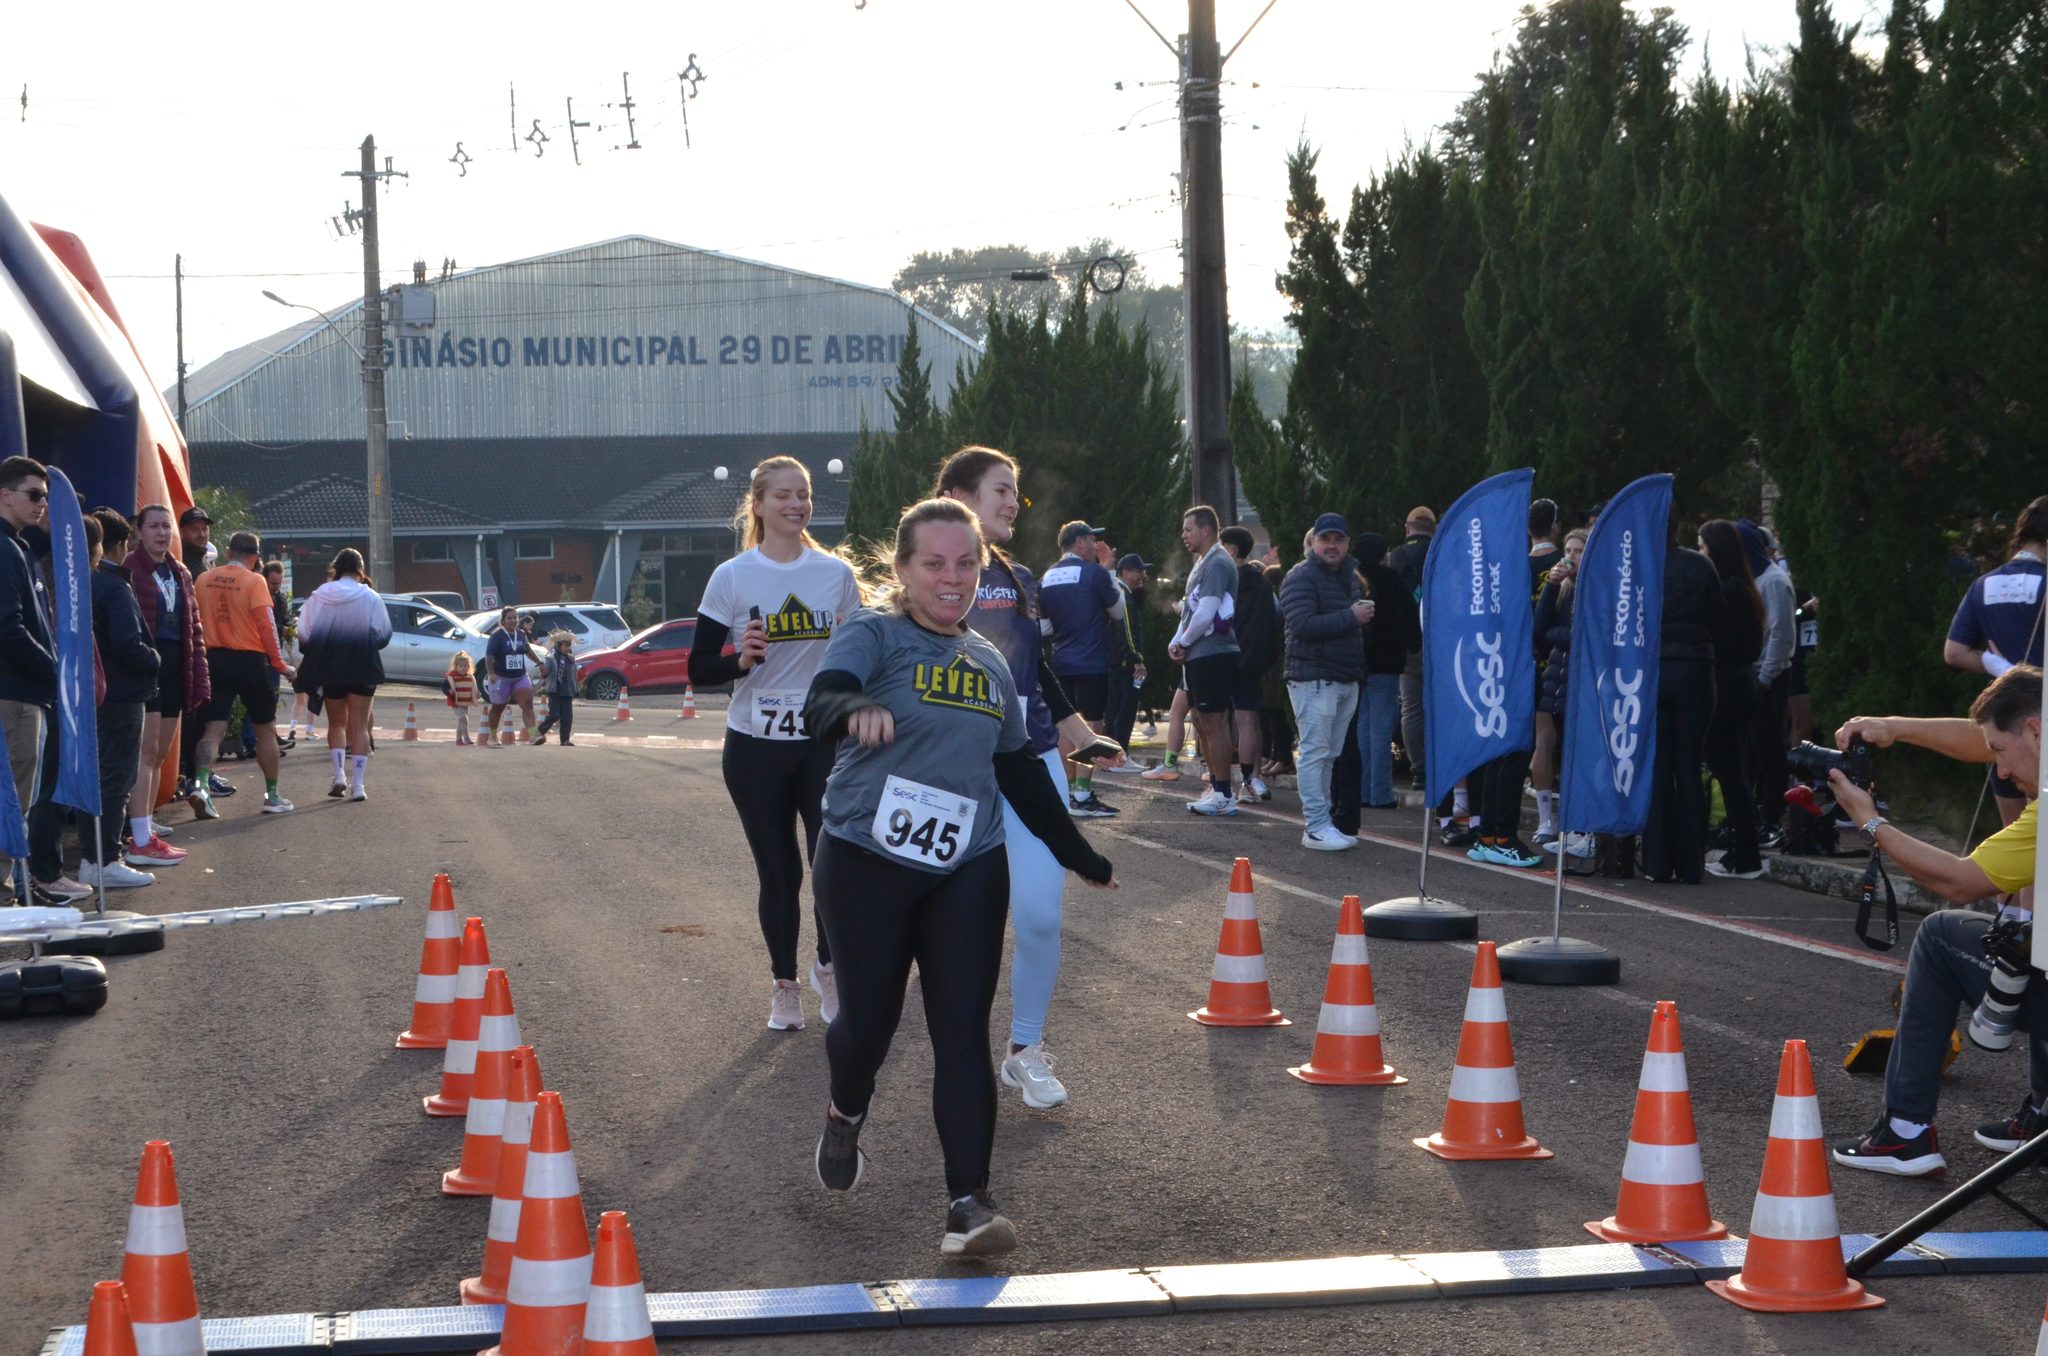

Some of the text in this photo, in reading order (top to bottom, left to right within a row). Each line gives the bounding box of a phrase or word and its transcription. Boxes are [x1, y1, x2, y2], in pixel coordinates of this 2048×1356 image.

[383, 330, 511, 368] GINÁSIO
[523, 335, 708, 367] MUNICIPAL
[719, 335, 761, 365] 29
[771, 335, 813, 365] DE
[1468, 517, 1485, 616] Fecomércio
[1613, 530, 1633, 647] Fecomércio
[508, 659, 522, 668] 981
[885, 807, 961, 862] 945
